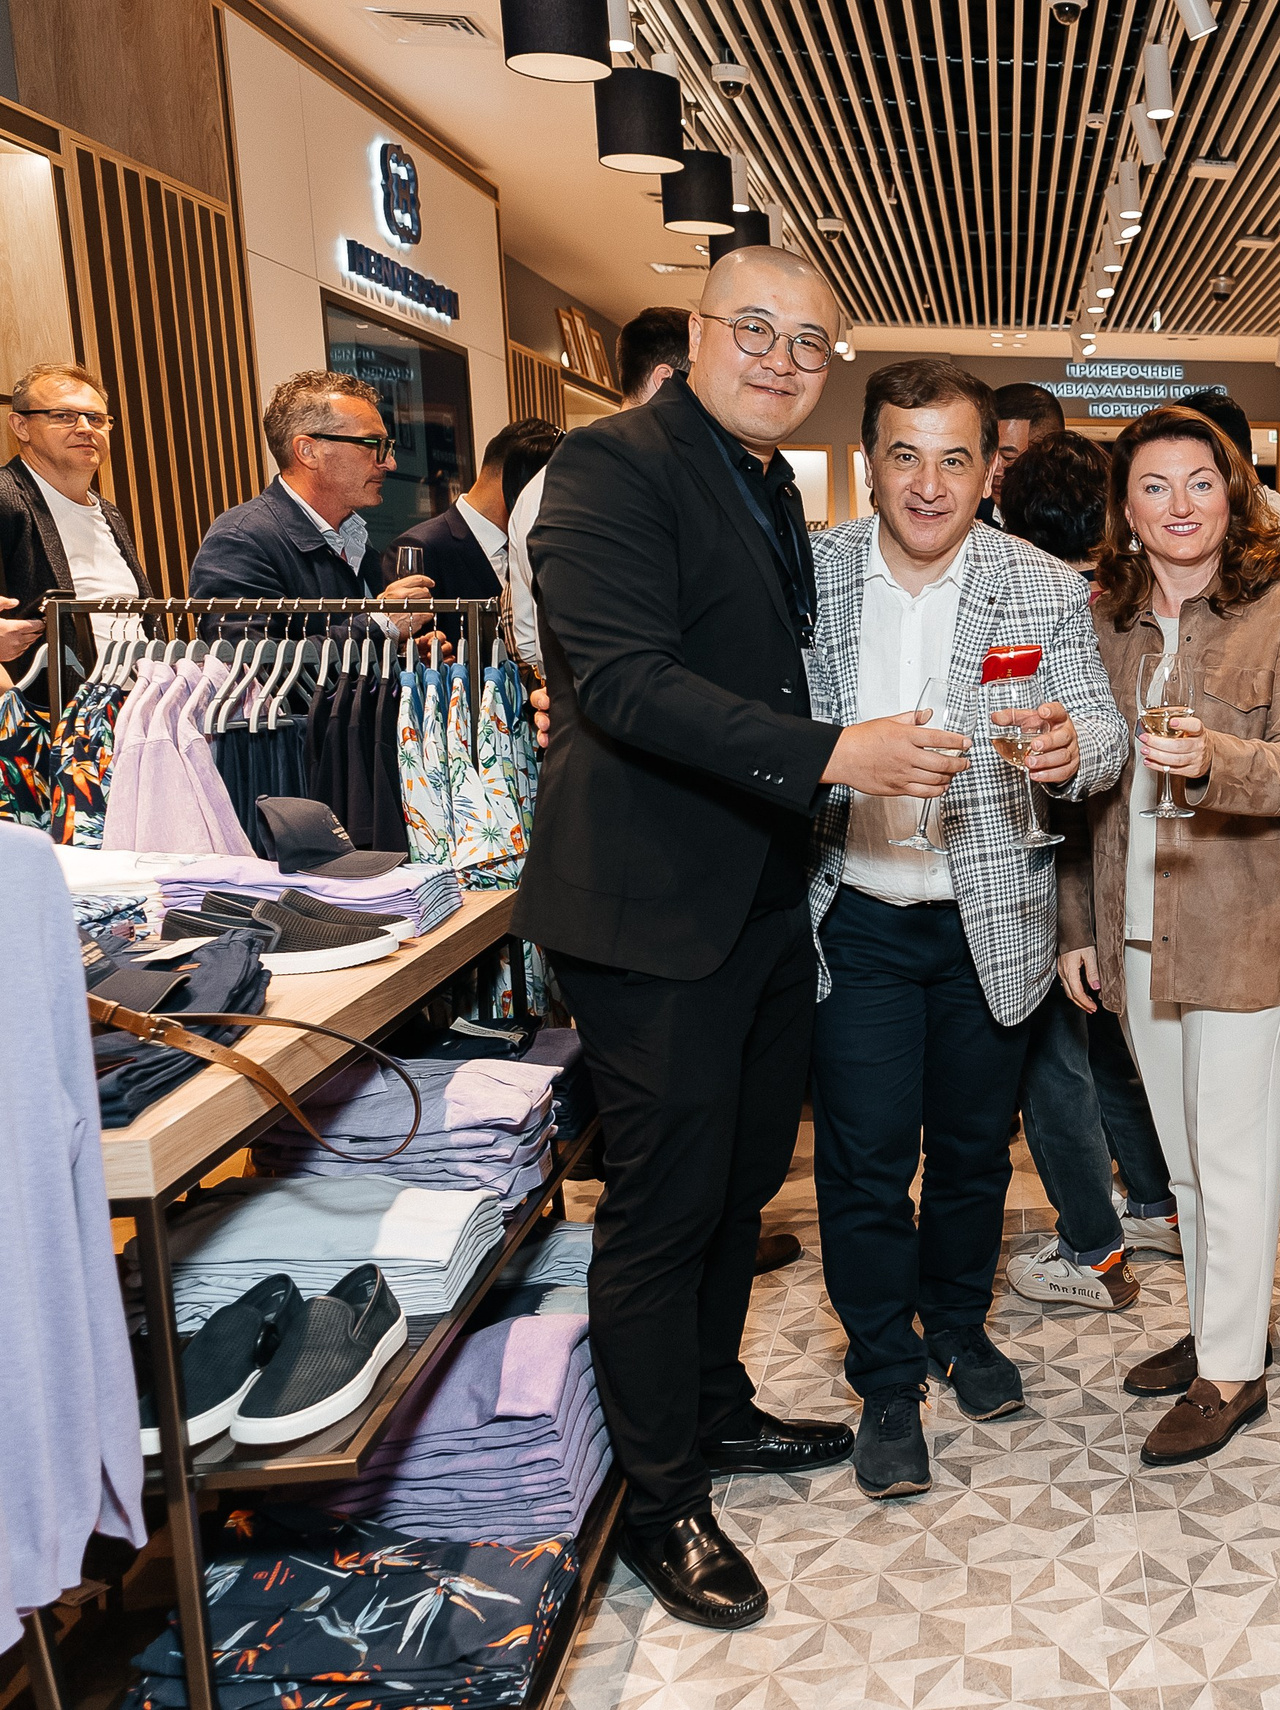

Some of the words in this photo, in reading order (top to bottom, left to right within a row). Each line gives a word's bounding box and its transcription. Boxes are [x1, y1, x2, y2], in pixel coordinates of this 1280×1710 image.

[347, 239, 460, 320] HENDERSON
[1067, 364, 1184, 379] ПРИМЕРОЧНЫЕ
[1036, 383, 1167, 398] ДИВИДУАЛЬНЫЙ
[1072, 1287, 1101, 1300] SMILE
